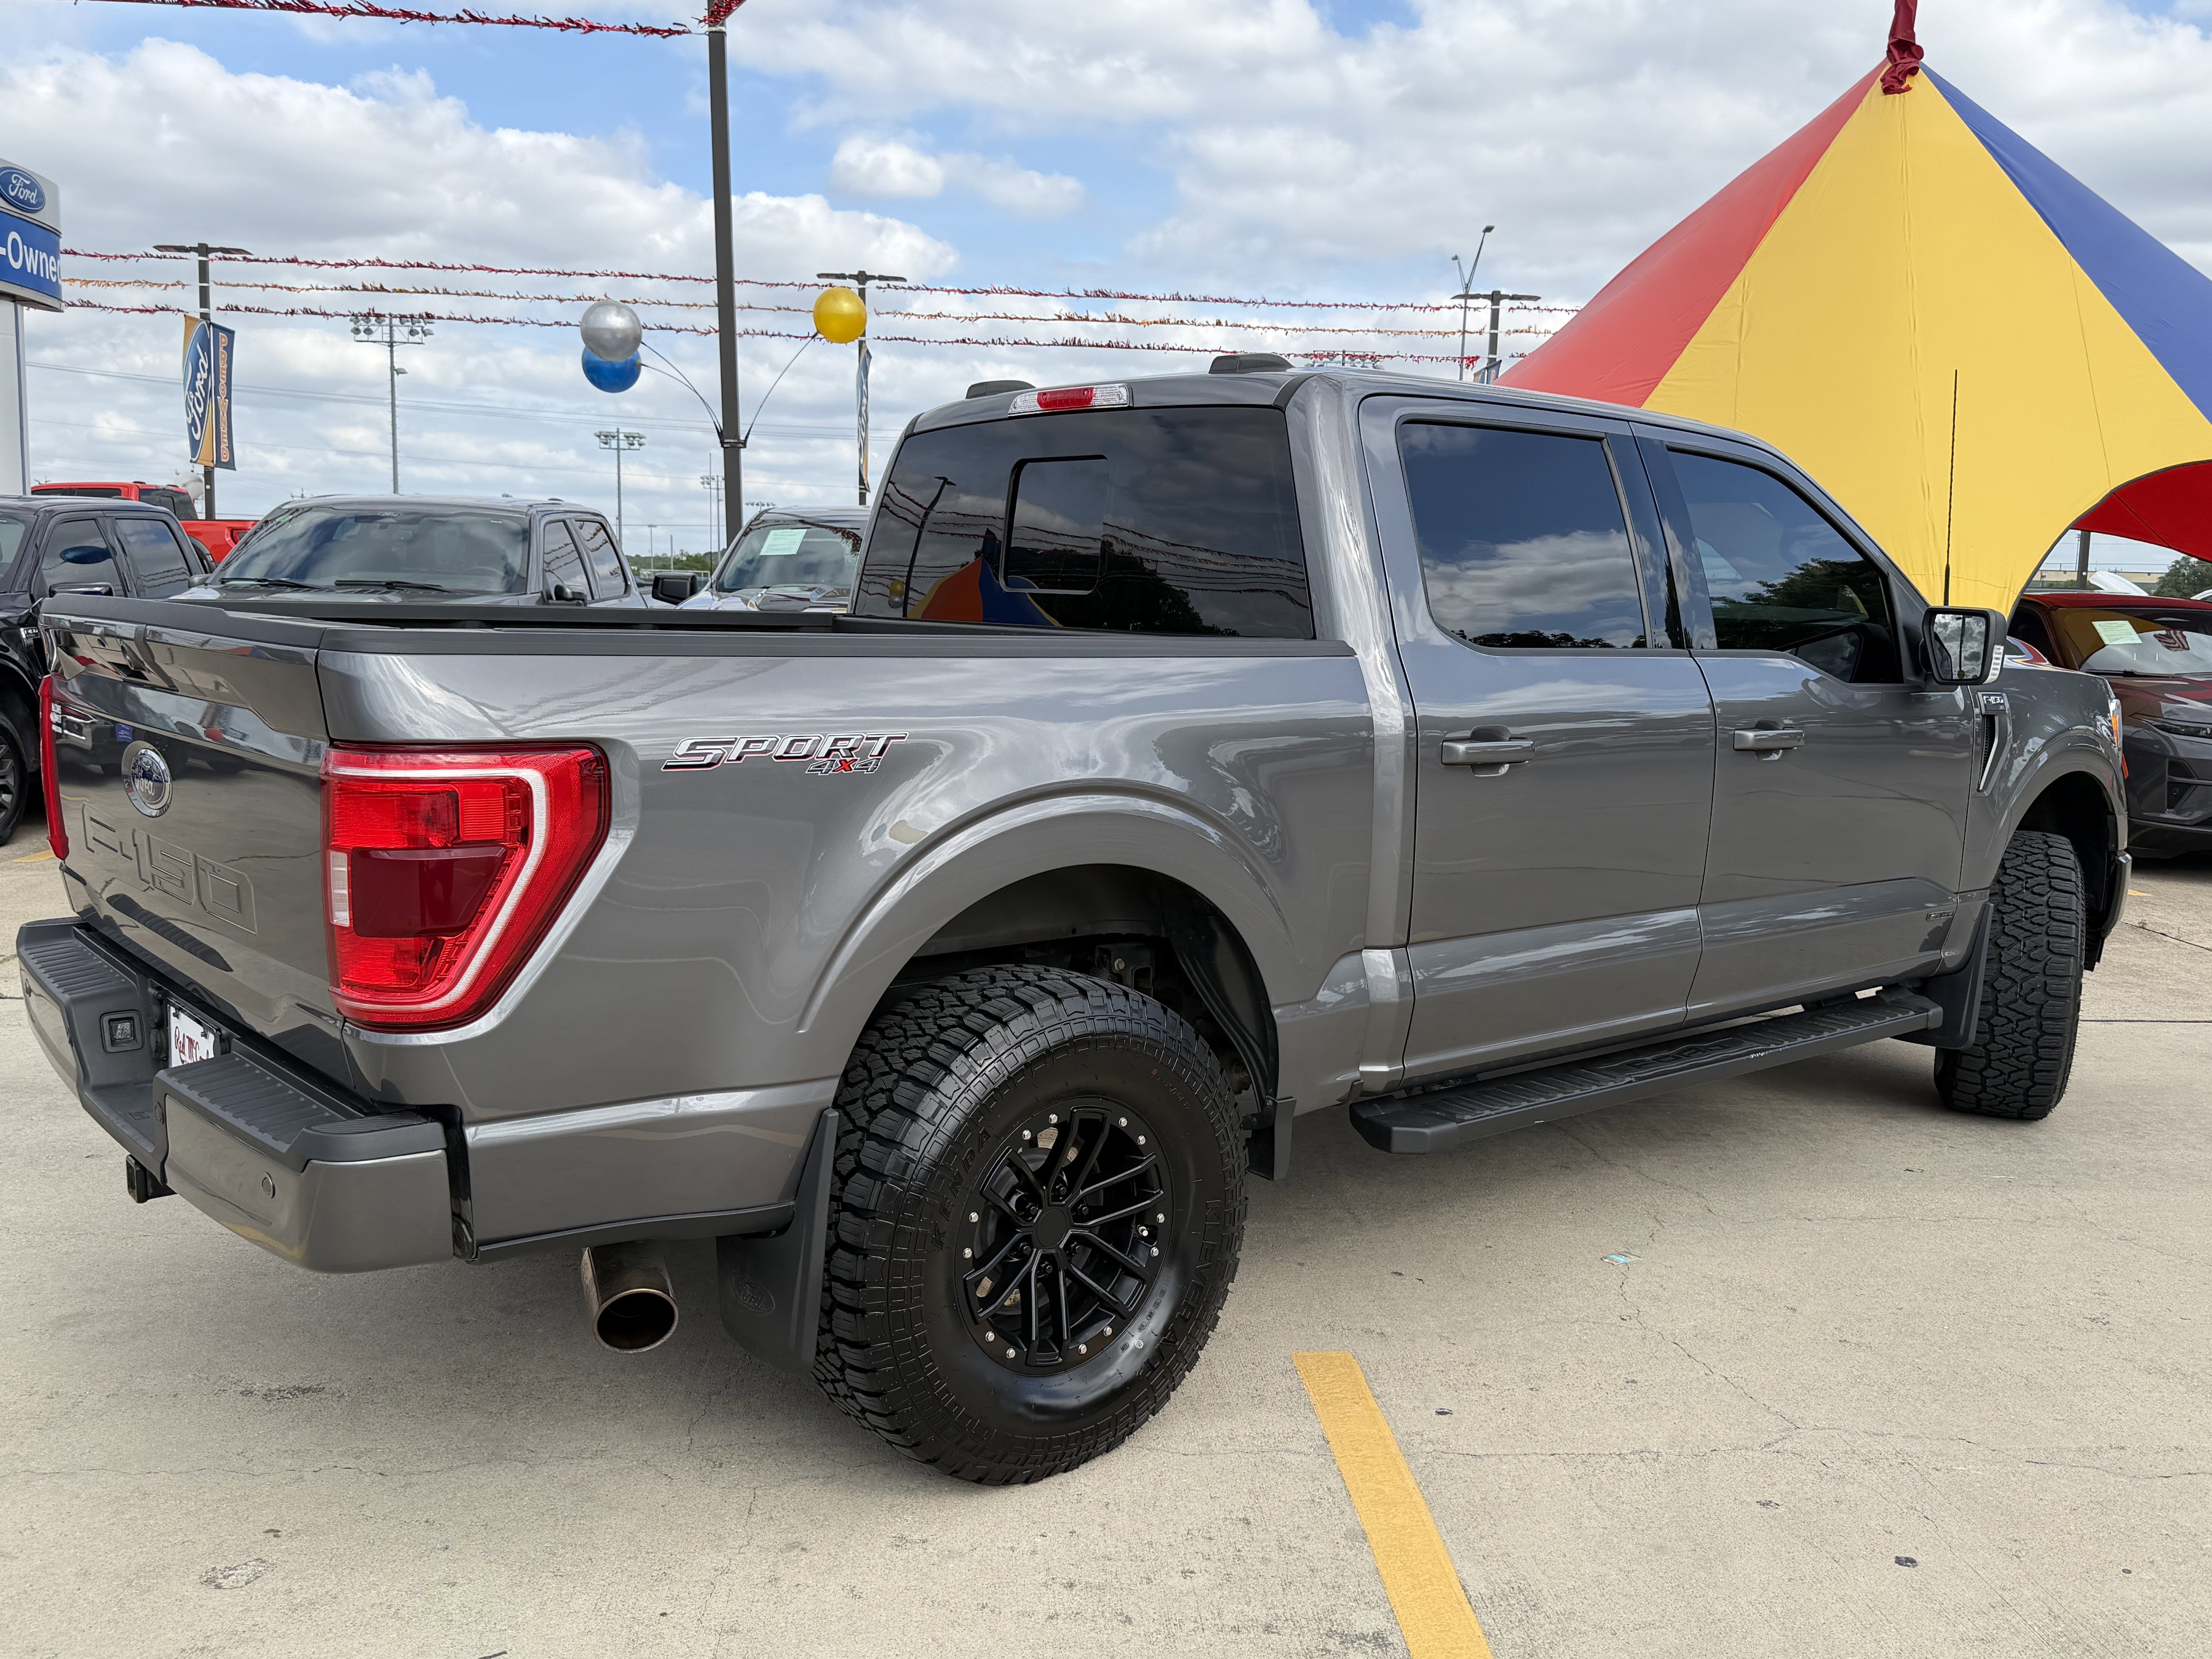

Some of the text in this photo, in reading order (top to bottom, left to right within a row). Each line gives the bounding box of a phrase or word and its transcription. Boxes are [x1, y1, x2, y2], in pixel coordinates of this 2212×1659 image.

[9, 173, 38, 204] Ford
[185, 342, 209, 441] Ford
[661, 732, 909, 771] SPORT
[82, 801, 258, 935] F-150
[931, 1127, 992, 1250] KENDA
[1175, 1199, 1223, 1324] KLEVER
